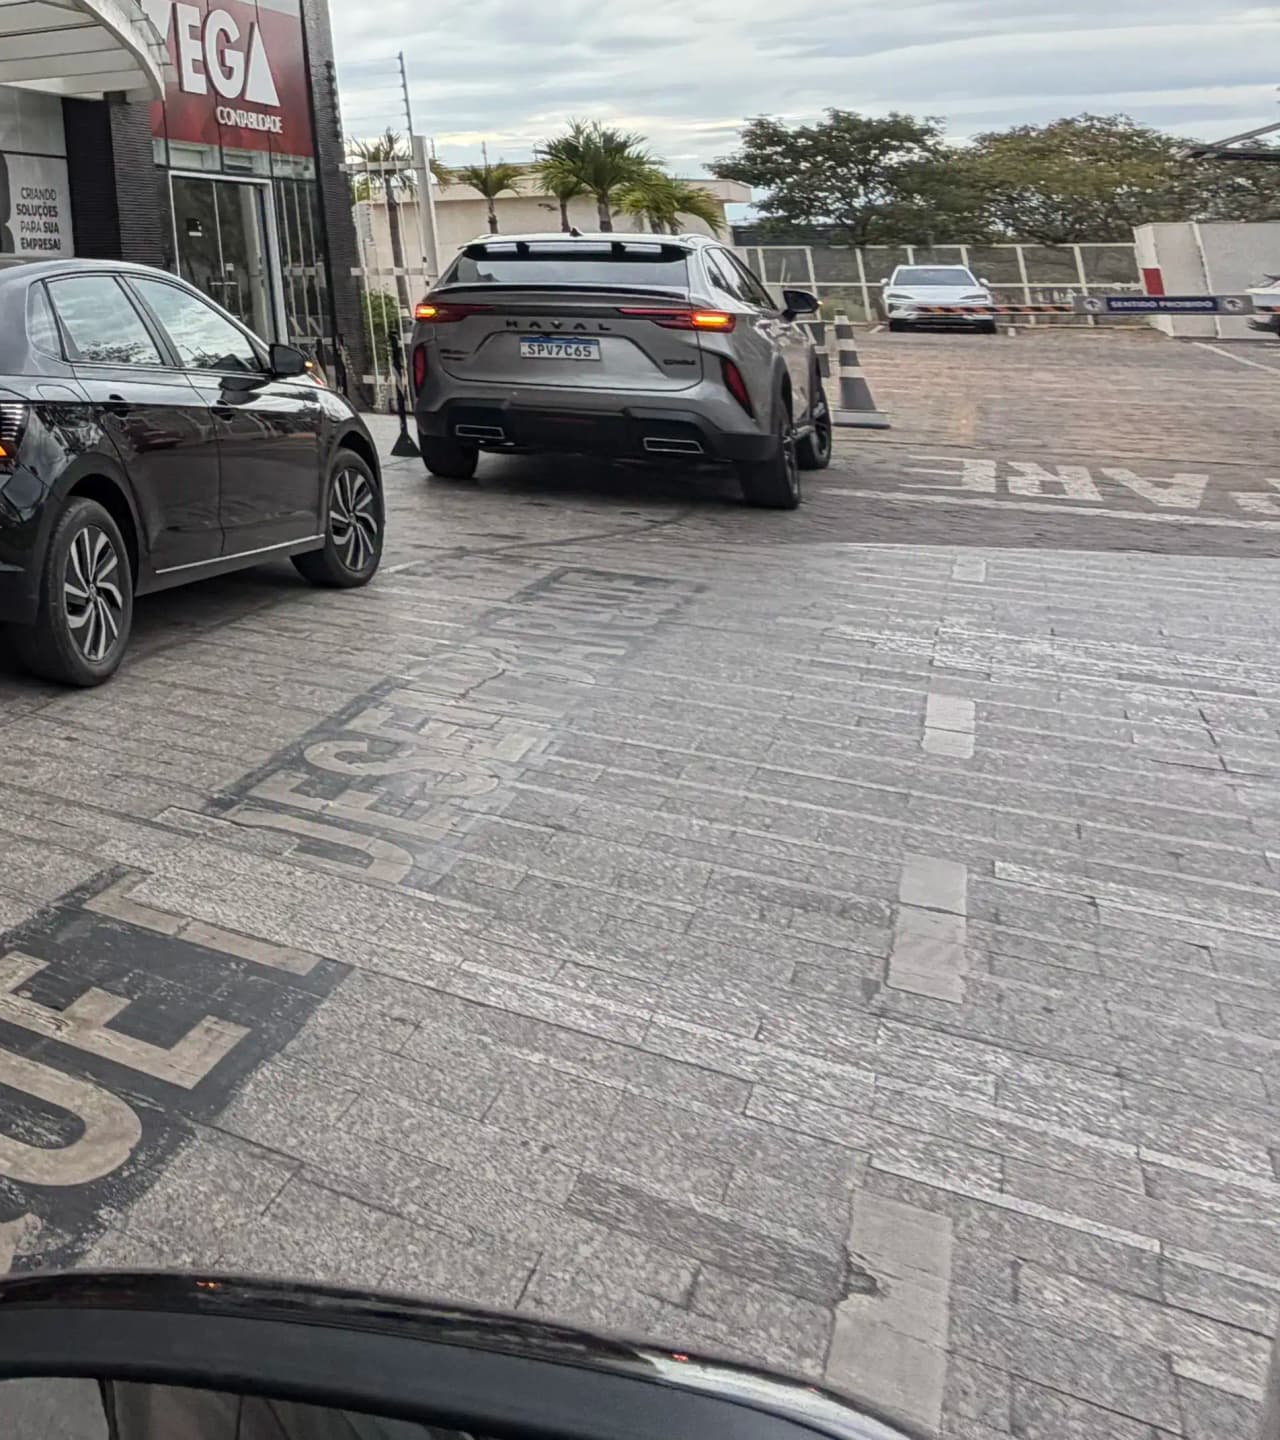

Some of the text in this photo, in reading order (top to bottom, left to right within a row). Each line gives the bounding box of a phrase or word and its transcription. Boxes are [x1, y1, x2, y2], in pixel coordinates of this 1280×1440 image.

[20, 186, 57, 201] CRIANDO
[16, 201, 59, 220] SOLUÇÕES
[20, 220, 60, 234] PARA SUA
[1110, 300, 1157, 309] SENTIDO
[505, 319, 612, 331] HAVAL
